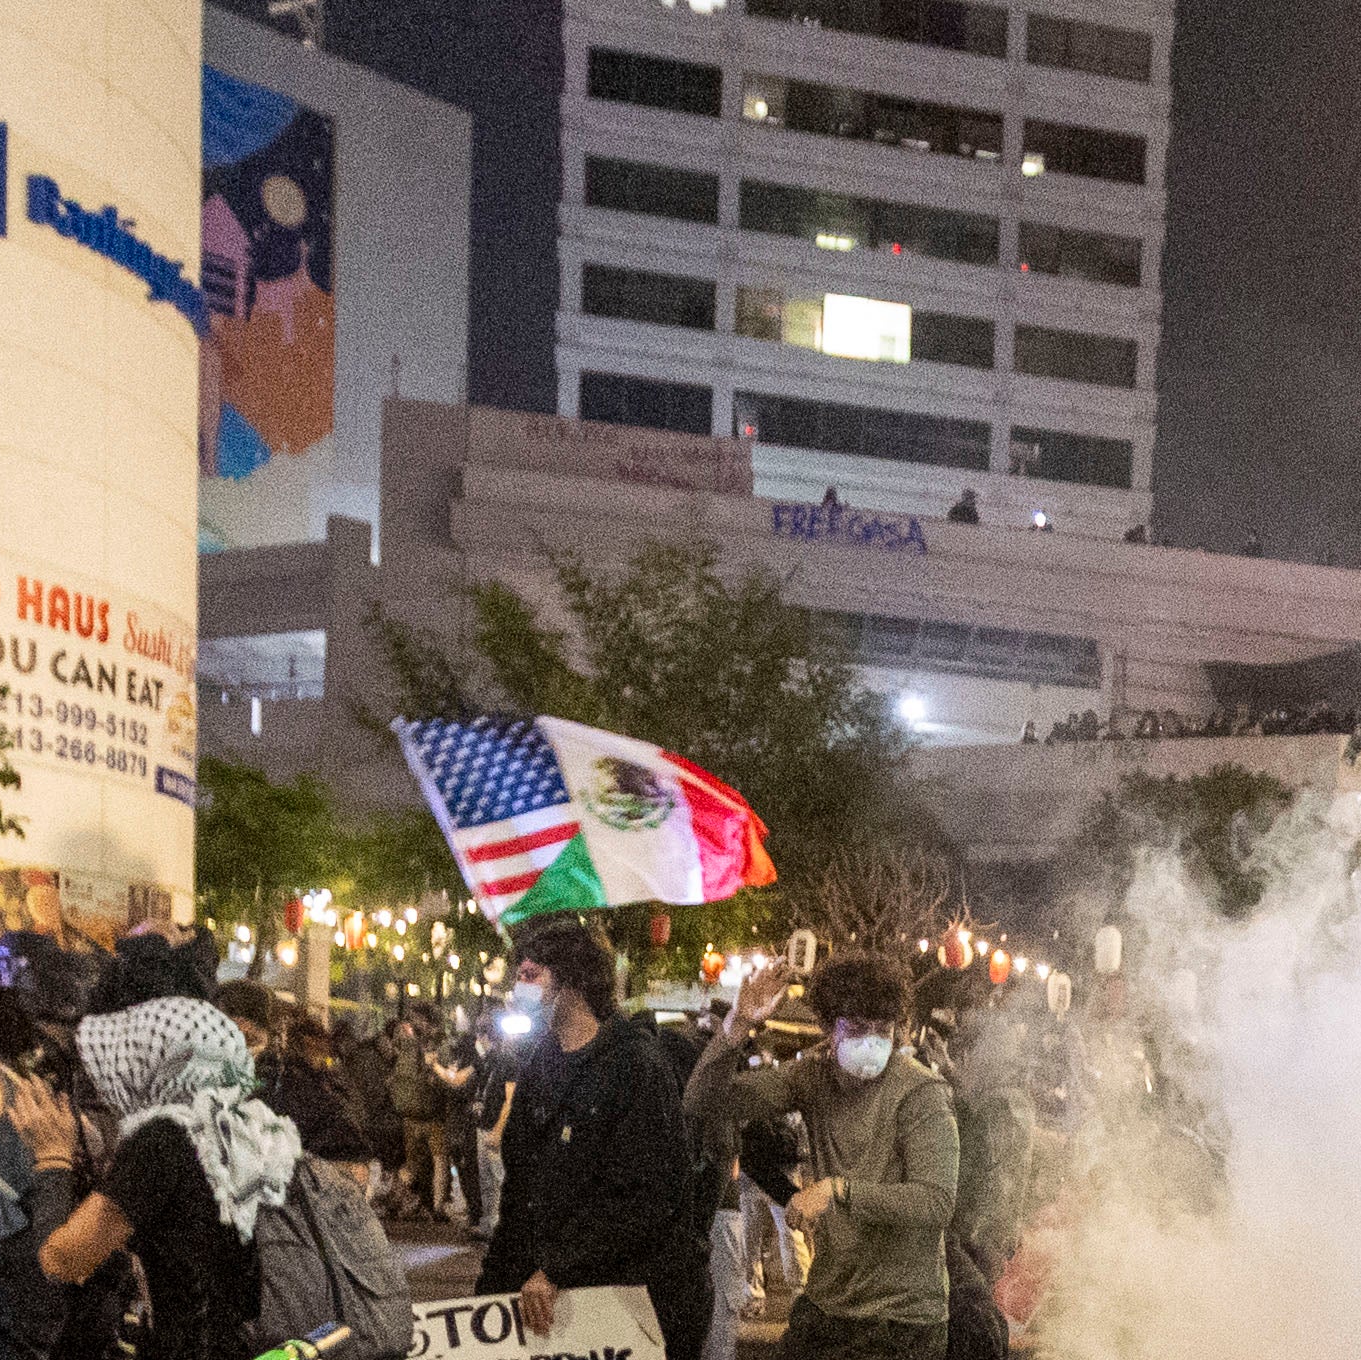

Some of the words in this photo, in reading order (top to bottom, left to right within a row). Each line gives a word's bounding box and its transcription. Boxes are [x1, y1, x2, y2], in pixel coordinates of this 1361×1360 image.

[16, 575, 110, 643] HAUS
[122, 609, 172, 668] Sushi
[49, 649, 117, 697] CAN
[126, 666, 164, 711] EAT
